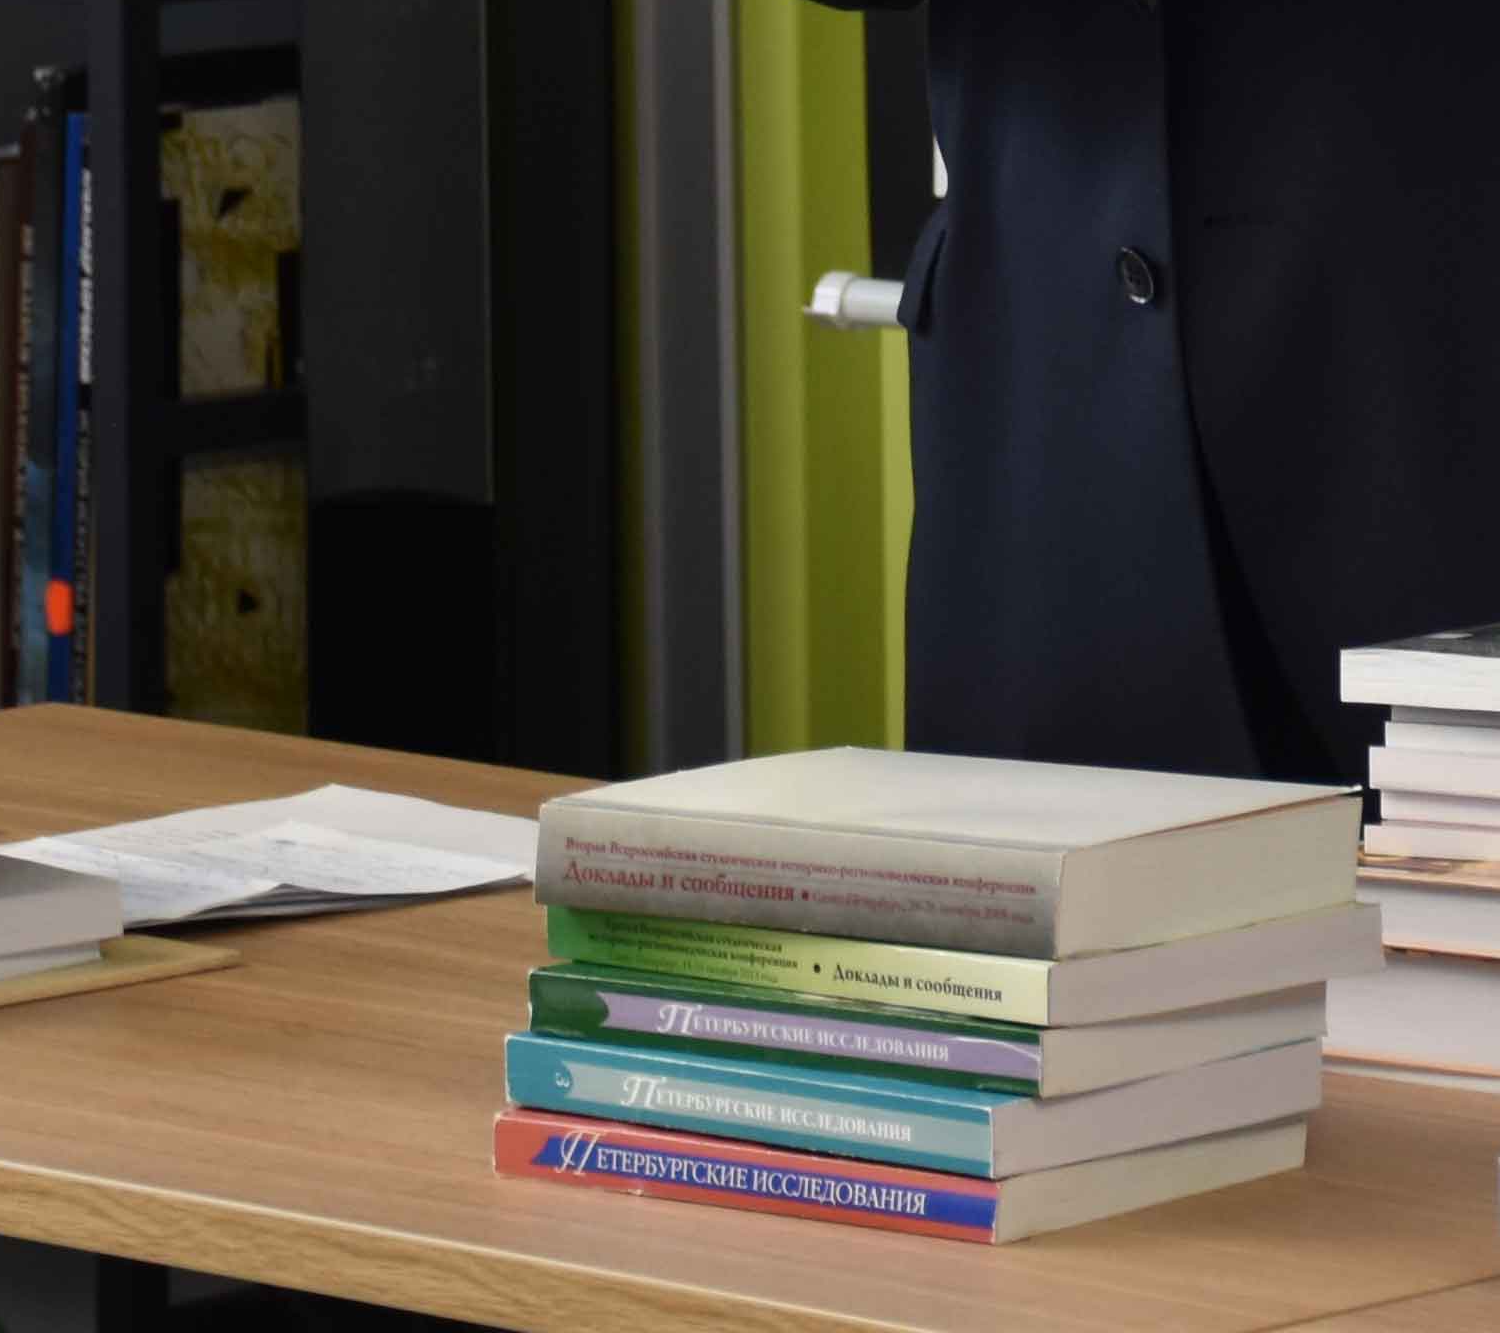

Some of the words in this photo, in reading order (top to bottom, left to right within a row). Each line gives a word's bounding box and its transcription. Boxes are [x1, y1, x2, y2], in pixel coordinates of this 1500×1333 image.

[563, 859, 655, 889] Доклады
[658, 871, 675, 889] и
[681, 873, 796, 903] сообщения
[832, 962, 900, 990] Доклады
[903, 976, 913, 990] и
[915, 976, 1003, 1003] сообщения
[655, 1004, 819, 1046] ПЕТЕРБУРГСКИЕ
[818, 1027, 950, 1062] ИССЛЕДОВАНИЯ
[620, 1075, 776, 1122] ПЕТЕРБУРГСКИЕ
[779, 1107, 912, 1143] ИССЛЕДОВАНИЯ
[554, 1130, 749, 1188] ПЕТЕРБУРГСКИЕ
[751, 1172, 928, 1216] ИССЛЕДОВАНИЯ
